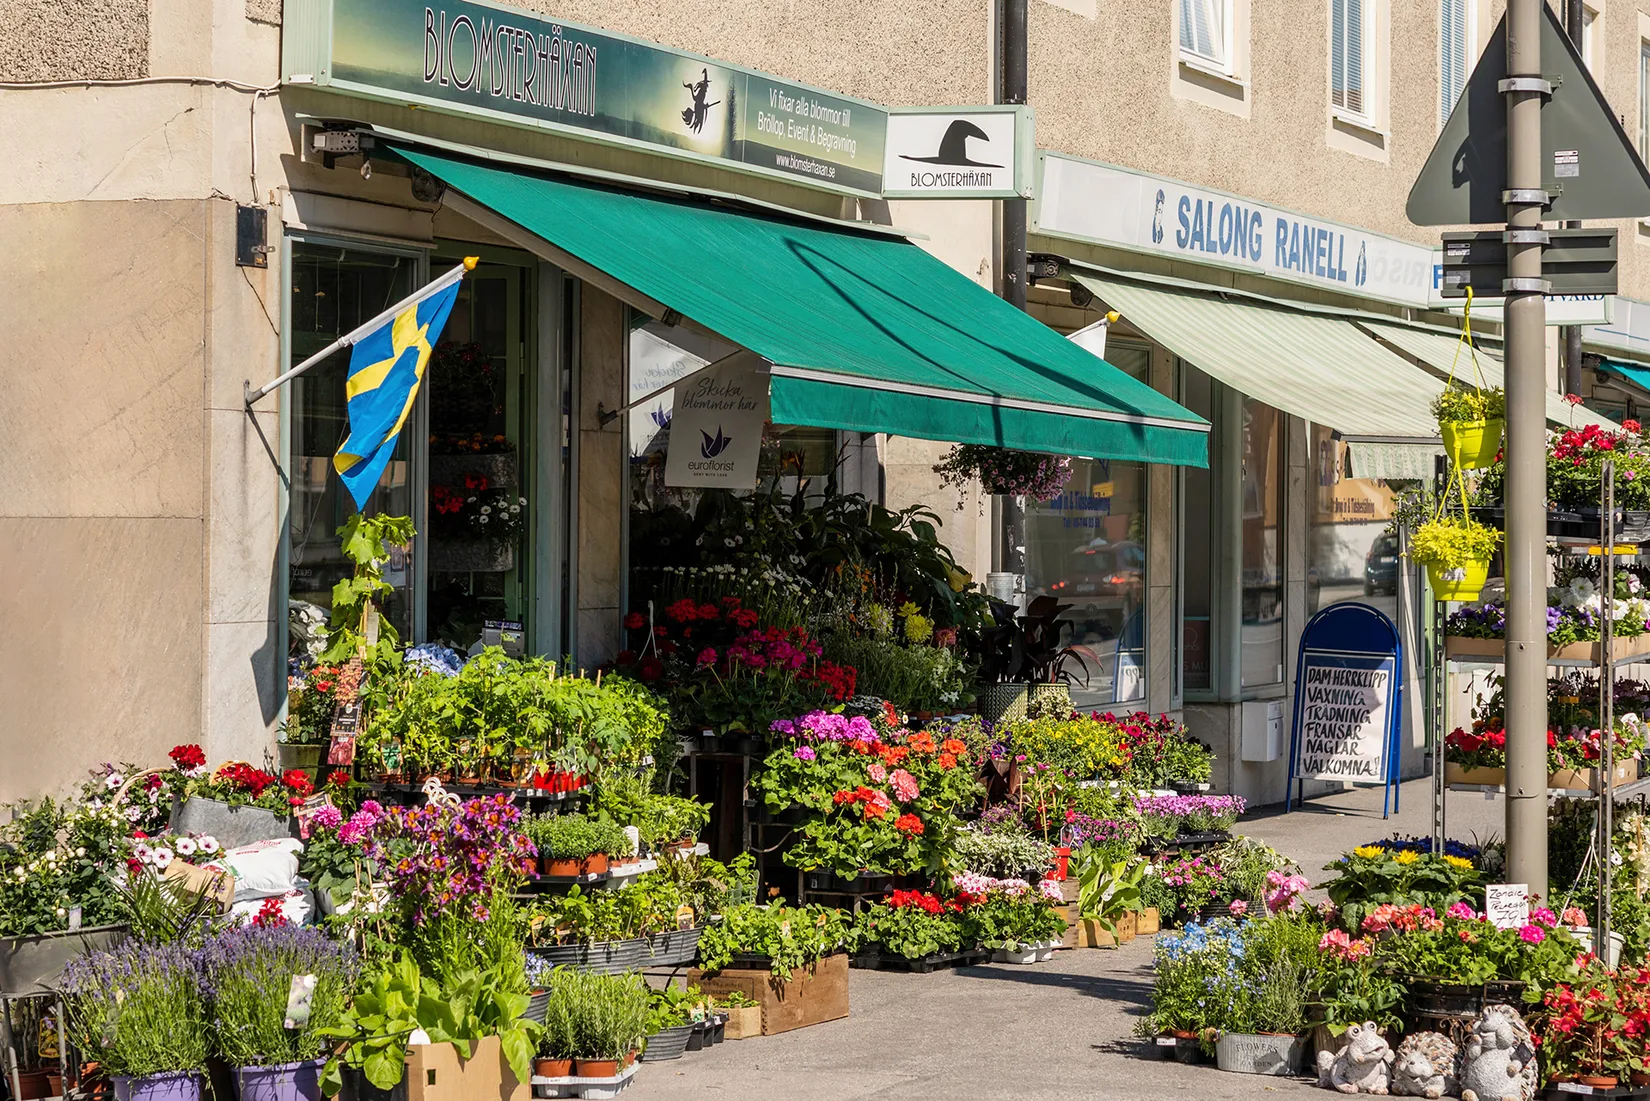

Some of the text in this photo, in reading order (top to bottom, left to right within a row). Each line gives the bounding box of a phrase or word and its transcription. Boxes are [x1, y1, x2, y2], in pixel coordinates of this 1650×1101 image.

[424, 7, 597, 116] BLOMSTERHÄXAN
[769, 87, 852, 128] Vi fixar alla blommor till
[757, 111, 857, 159] Bröllop, Event & Begravning
[775, 154, 836, 178] www.blomsterhaxan.se
[910, 170, 992, 187] BLOMSTERHÄXAN
[1176, 195, 1348, 283] SALONG RANELL
[697, 377, 744, 399] Skicka
[681, 391, 760, 412] blommor här
[687, 460, 735, 472] euroflorist
[1308, 687, 1366, 706] VAXNING
[1305, 722, 1366, 740] FRANSAR
[1306, 739, 1364, 755] NAGLAR
[1235, 1042, 1279, 1053] FLOWERS
